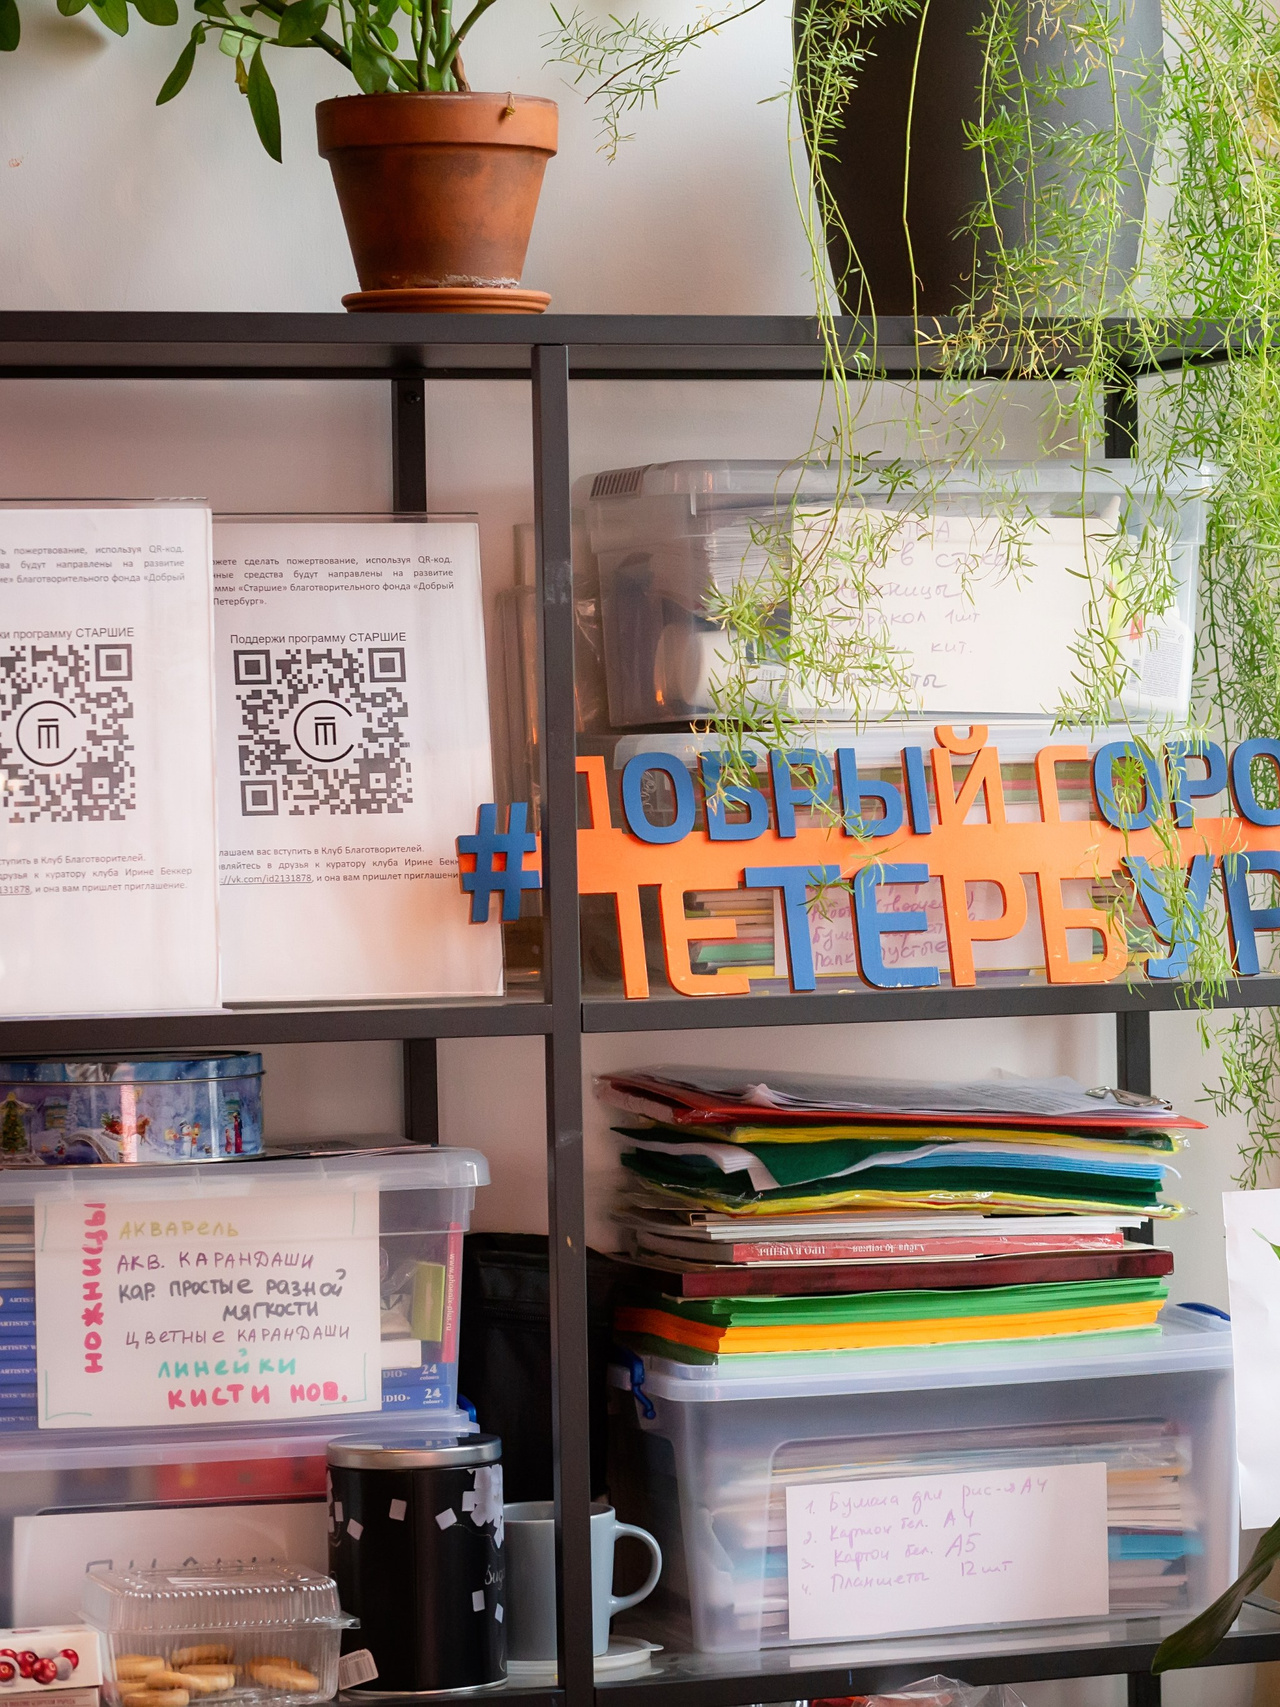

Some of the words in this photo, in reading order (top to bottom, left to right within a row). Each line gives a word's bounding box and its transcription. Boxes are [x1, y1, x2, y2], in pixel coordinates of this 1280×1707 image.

[13, 546, 88, 556] пожертвование,
[95, 545, 142, 555] используя
[149, 544, 185, 554] QR-код.
[20, 560, 46, 571] будут
[56, 560, 113, 570] направлены
[122, 560, 134, 568] на
[143, 559, 185, 569] развитие
[244, 557, 279, 567] сделать
[286, 556, 359, 567] пожертвование,
[365, 555, 411, 566] используя
[418, 555, 453, 565] QR-код.
[16, 574, 109, 584] благотворительного
[111, 573, 141, 585] фонда
[143, 572, 185, 583] «Добрый
[244, 570, 284, 580] средства
[293, 569, 319, 580] будут
[328, 569, 383, 579] направлены
[392, 569, 404, 577] на
[413, 568, 454, 578] развитие
[238, 583, 288, 593] «Старшие»
[290, 581, 380, 593] благотворительного
[382, 581, 411, 592] фонда
[413, 580, 454, 591] «Добрый
[13, 630, 72, 641] программу
[75, 627, 135, 638] СТАРШИЕ
[230, 634, 286, 646] Поддержи
[288, 634, 346, 645] программу
[349, 632, 406, 642] СТАРШИЕ
[274, 848, 312, 858] вступить
[321, 846, 343, 857] Клуб
[345, 845, 424, 856] Благотворителей.
[34, 857, 39, 865] в
[41, 855, 63, 866] Клуб
[65, 853, 146, 865] Благотворителей.
[278, 861, 309, 871] друзья
[326, 859, 366, 870] куратору
[372, 858, 398, 868] клуба
[404, 857, 433, 866] Ирине
[439, 857, 459, 866] Бекк
[45, 870, 86, 881] куратору
[92, 868, 119, 878] клуба
[125, 867, 154, 876] Ирине
[160, 866, 193, 878] Беккер
[325, 874, 340, 882] она
[363, 872, 402, 882] пришлет
[404, 871, 458, 882] приглашени
[35, 885, 41, 893] и
[43, 885, 60, 893] она
[62, 884, 80, 892] вам
[82, 883, 122, 893] пришлет
[124, 882, 187, 893] приглашение.
[422, 1364, 438, 1375] 24
[425, 1387, 442, 1399] 24
[484, 1564, 506, 1591] Sug
